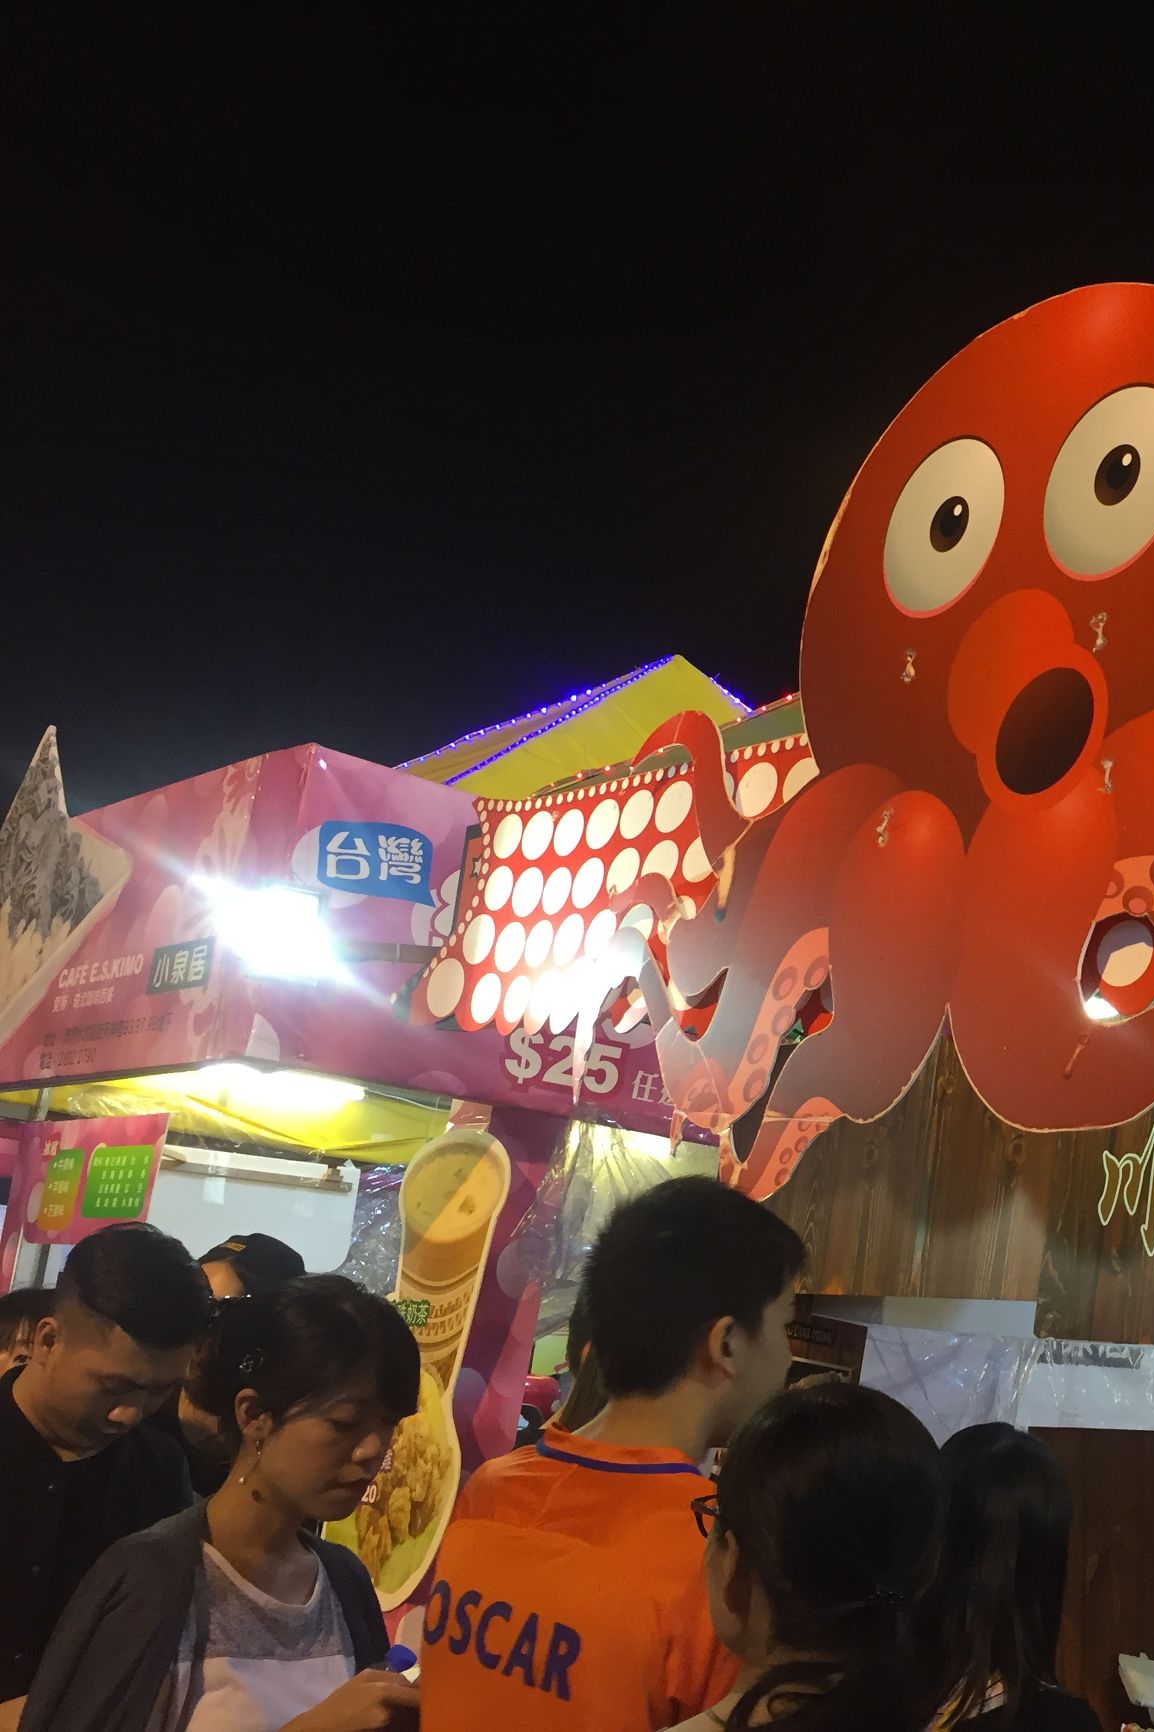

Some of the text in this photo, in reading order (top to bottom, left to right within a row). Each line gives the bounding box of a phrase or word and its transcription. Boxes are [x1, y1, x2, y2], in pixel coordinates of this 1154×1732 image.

[326, 832, 423, 884] 台灣
[58, 965, 87, 989] CAFE
[153, 945, 208, 988] 小泉居
[505, 1027, 622, 1094] $25
[423, 1579, 581, 1701] OSCAR
